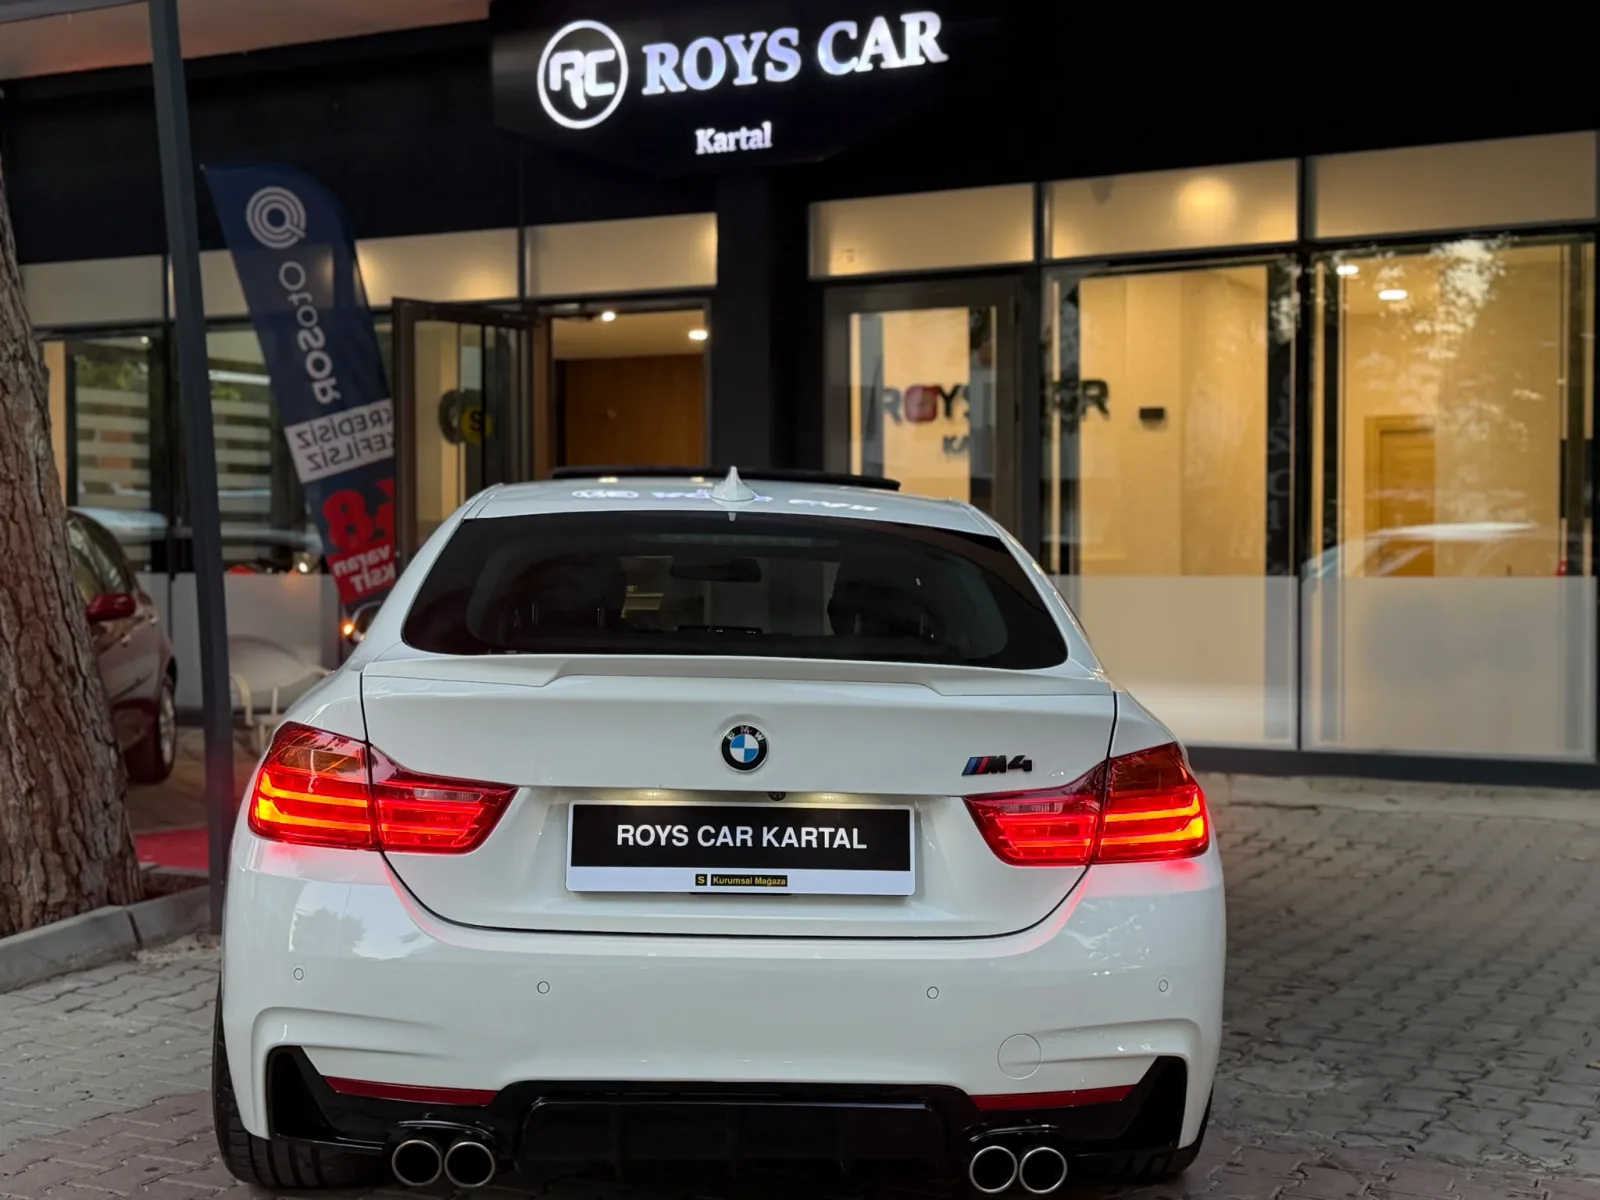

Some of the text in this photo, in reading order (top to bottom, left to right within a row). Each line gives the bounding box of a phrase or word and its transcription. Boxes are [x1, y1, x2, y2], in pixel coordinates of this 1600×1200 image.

[642, 11, 949, 96] ROYS CAR
[695, 121, 774, 155] Kartal
[616, 824, 867, 850] ROYS CAR KARTAL
[712, 875, 753, 885] Kurumsal
